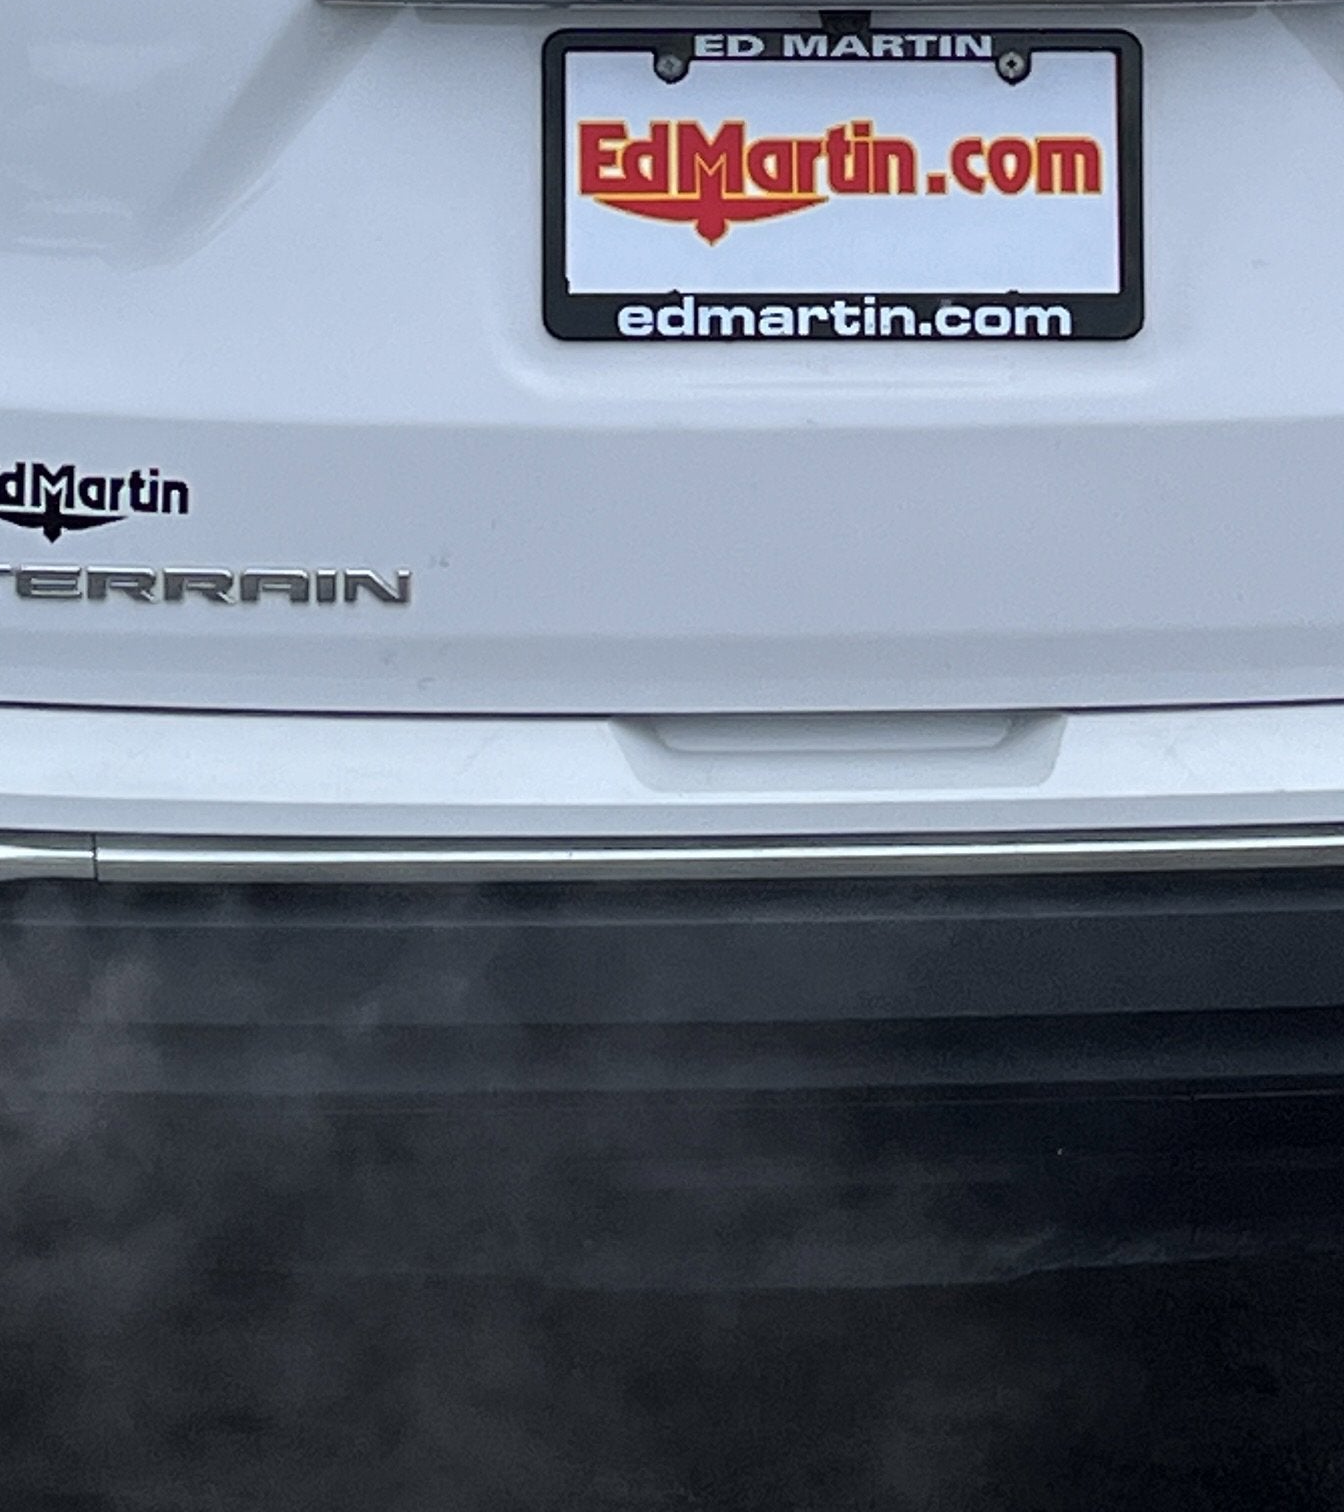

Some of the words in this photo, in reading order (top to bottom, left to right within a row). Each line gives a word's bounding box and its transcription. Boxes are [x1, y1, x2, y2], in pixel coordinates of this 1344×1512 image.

[693, 36, 763, 58] ED
[782, 35, 993, 58] MARTIN
[577, 120, 1103, 199] EdMartin.com
[617, 296, 1072, 338] edmartin.com
